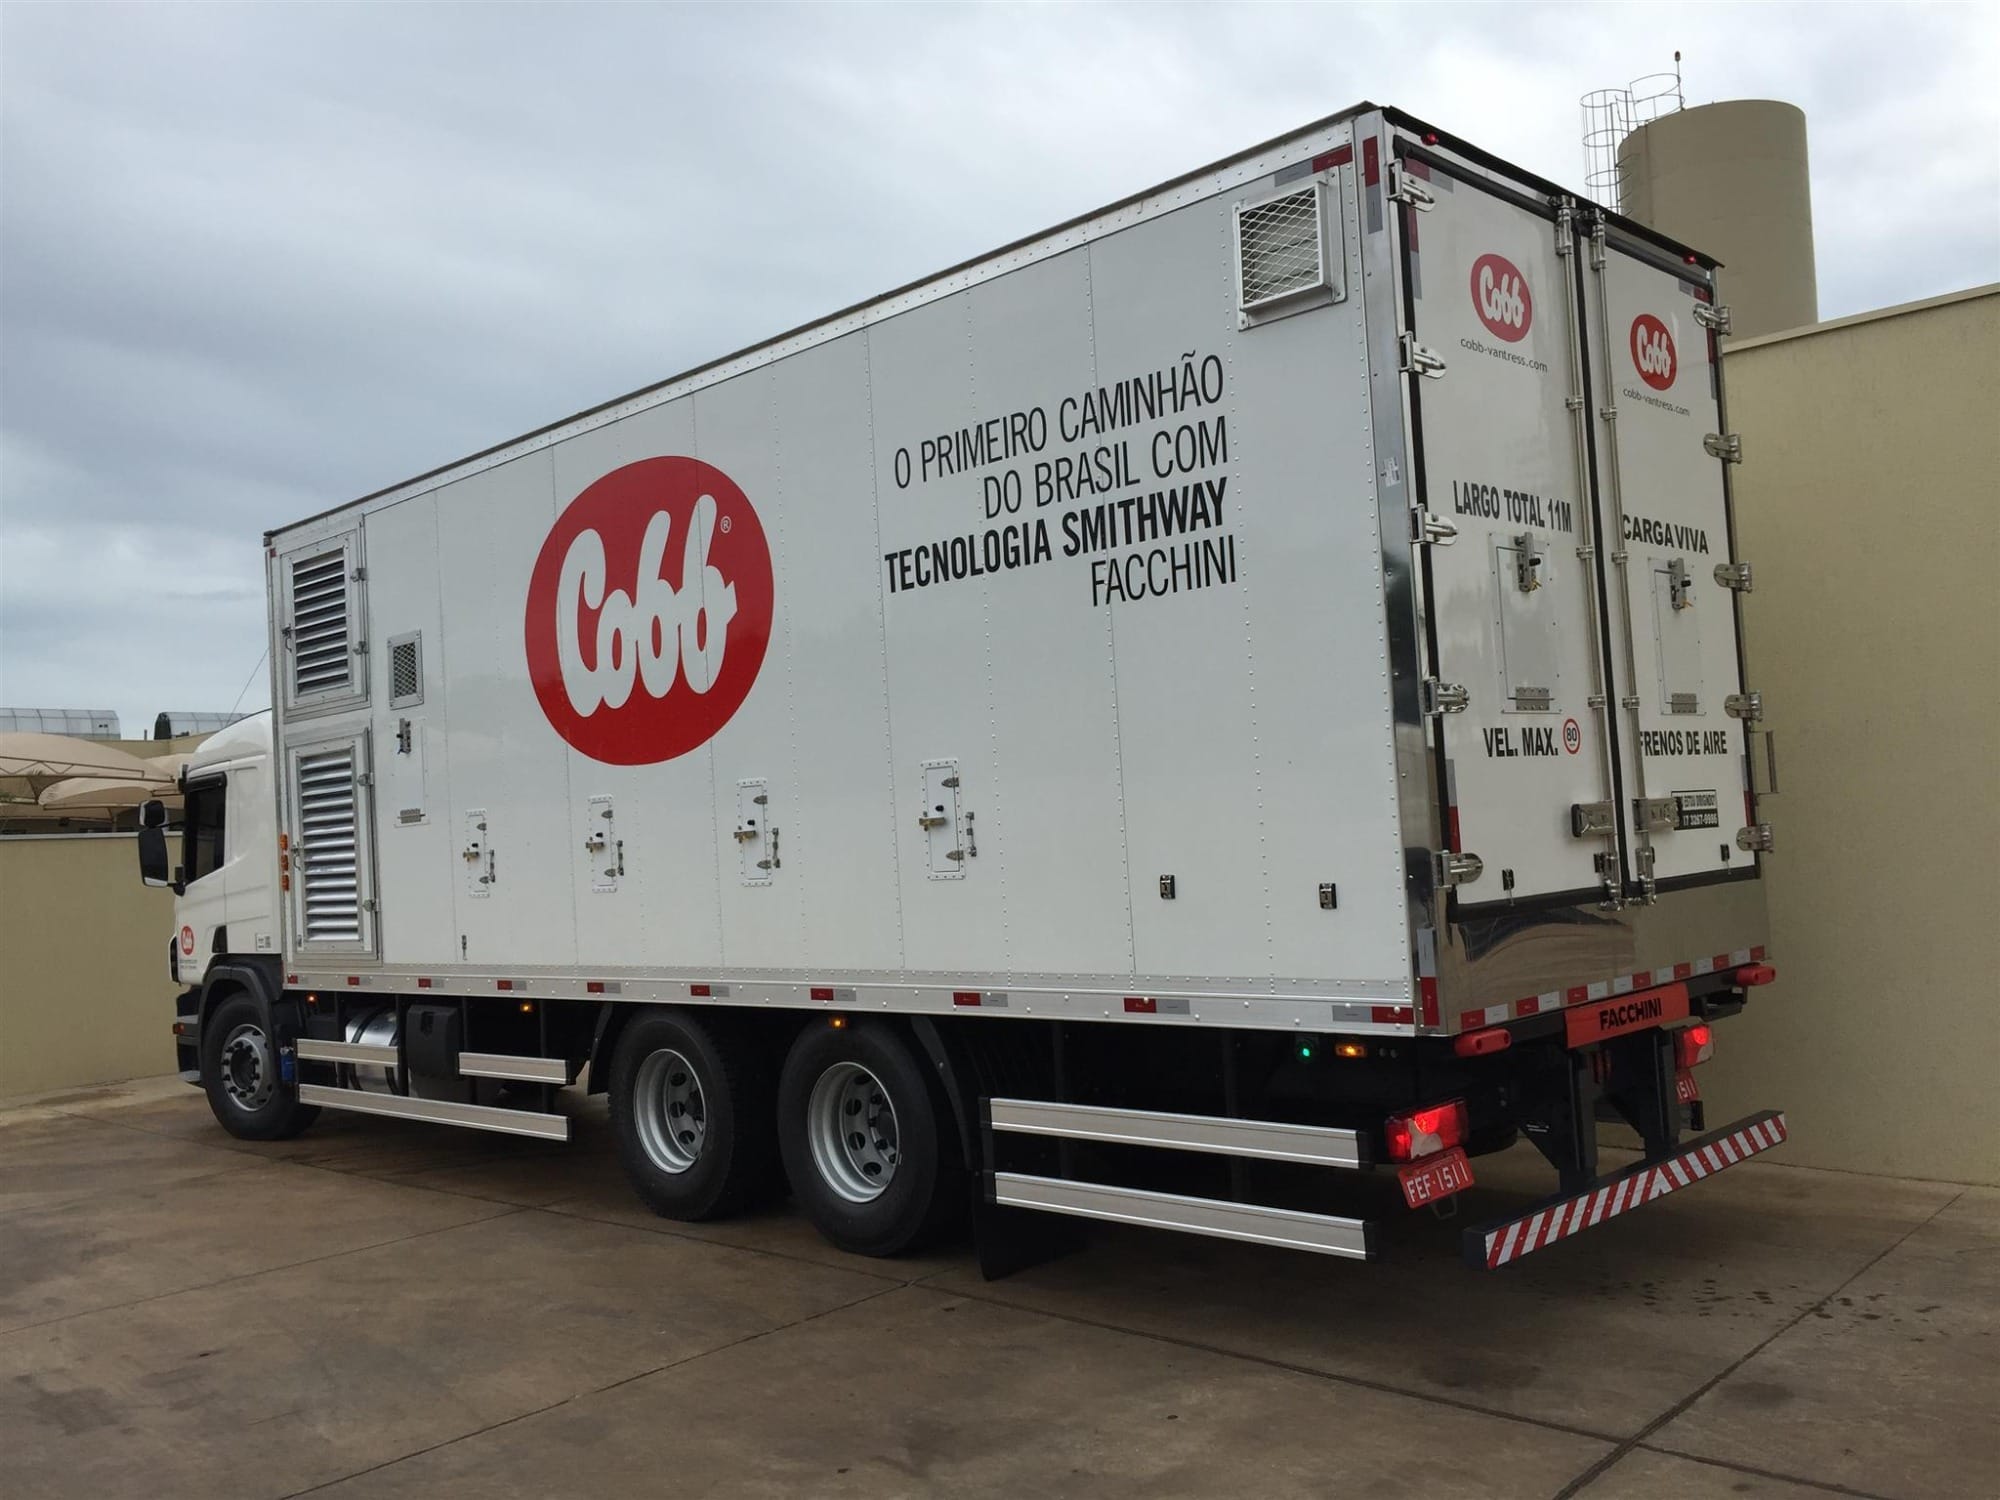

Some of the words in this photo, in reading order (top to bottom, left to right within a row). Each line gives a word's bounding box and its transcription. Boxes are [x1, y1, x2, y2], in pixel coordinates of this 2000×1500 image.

[1480, 264, 1525, 329] Cobb
[1460, 338, 1548, 373] cobb-vantress.com
[1637, 323, 1672, 379] Cobb
[894, 447, 911, 488] O
[921, 407, 1047, 482] PRIMEIRO
[1059, 349, 1224, 443] CAMINHÃO
[1622, 388, 1691, 416] cobb-vantress.com
[984, 469, 1022, 519] DO
[1034, 441, 1141, 507] BRASIL
[1151, 415, 1228, 478] COM
[1453, 479, 1500, 520] LARGO
[1503, 489, 1545, 528] TOTAL
[1547, 498, 1573, 533] 11M
[884, 518, 1052, 594] TECNOLOGIA
[1061, 476, 1228, 557] SMITHWAY
[1622, 513, 1675, 548] CARGA
[1674, 523, 1710, 555] VIVA
[1090, 534, 1237, 607] FACCHINI
[556, 494, 738, 718] Cobb
[1482, 727, 1519, 757] VEL.
[1521, 727, 1559, 756] MAX.
[1566, 727, 1578, 742] 80
[1685, 730, 1701, 755] DE
[1703, 730, 1728, 755] AIRE
[1599, 997, 1662, 1031] FACCHINI
